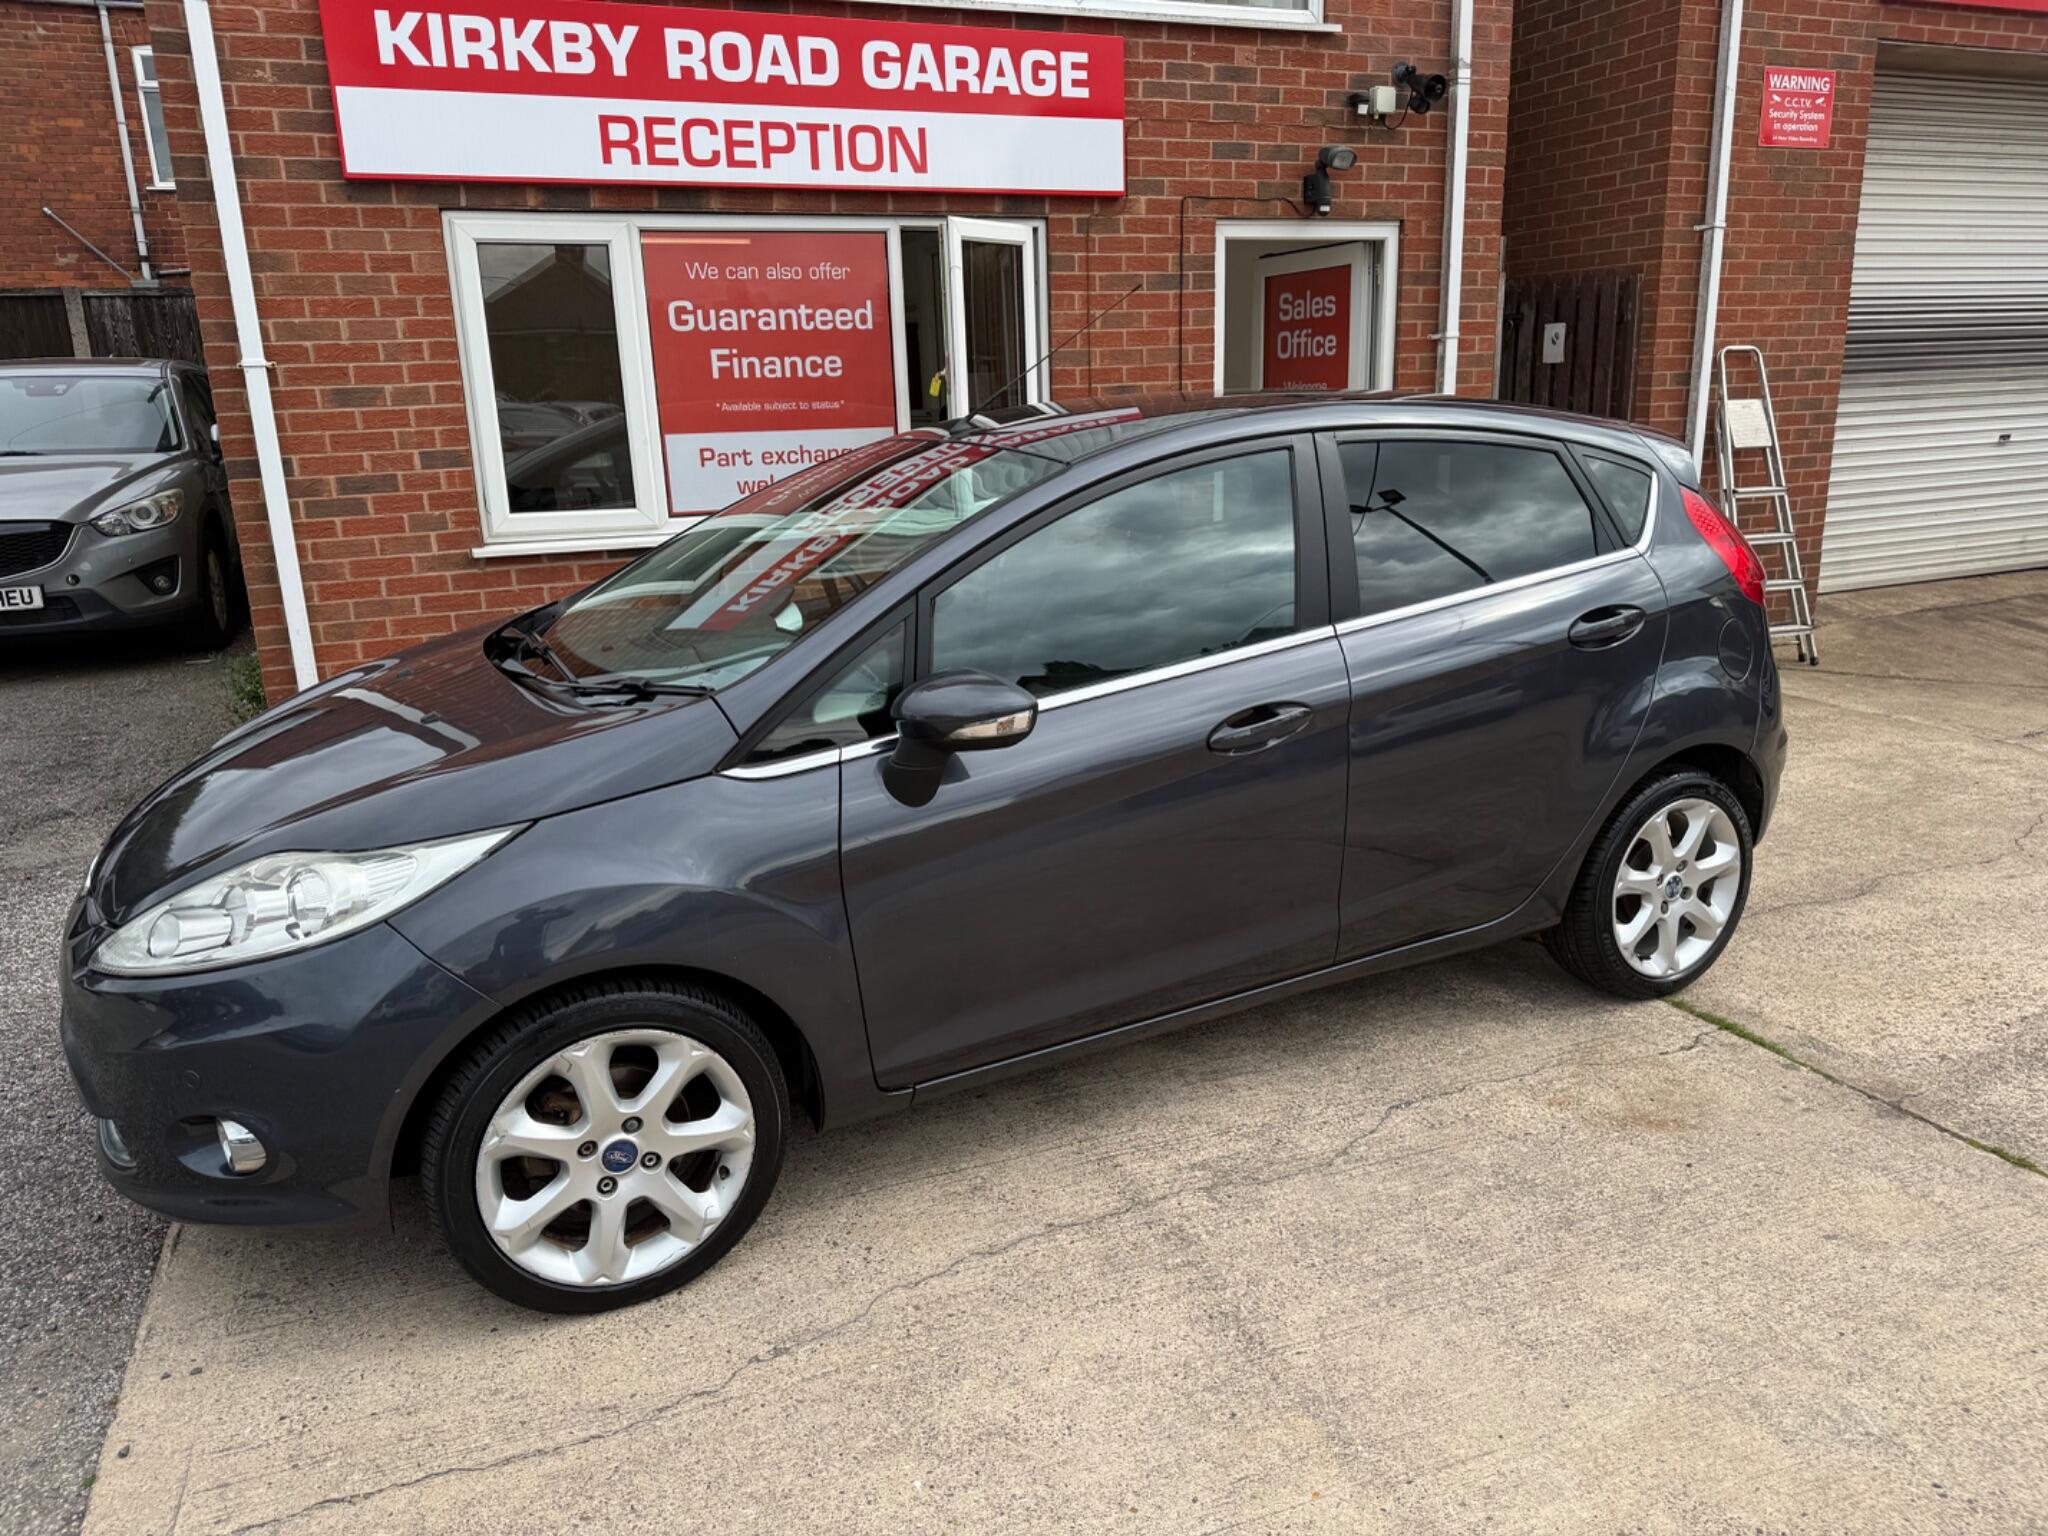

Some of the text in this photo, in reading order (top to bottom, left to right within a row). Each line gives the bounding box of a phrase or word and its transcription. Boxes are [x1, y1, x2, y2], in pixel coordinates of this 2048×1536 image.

[374, 9, 1090, 99] KIRKBY ROAD GARAGE
[1769, 74, 1830, 91] WARNING
[1769, 108, 1825, 121] Security System
[1782, 121, 1818, 132] operation
[598, 113, 928, 174] RECEPTION
[685, 262, 850, 280] We can also offer
[667, 300, 874, 332] Guaranteed
[1279, 290, 1336, 321] Sales
[1277, 328, 1337, 359] Office
[710, 348, 843, 379] Finance
[764, 401, 797, 412] subject
[799, 401, 809, 409] to
[699, 447, 753, 467] Part
